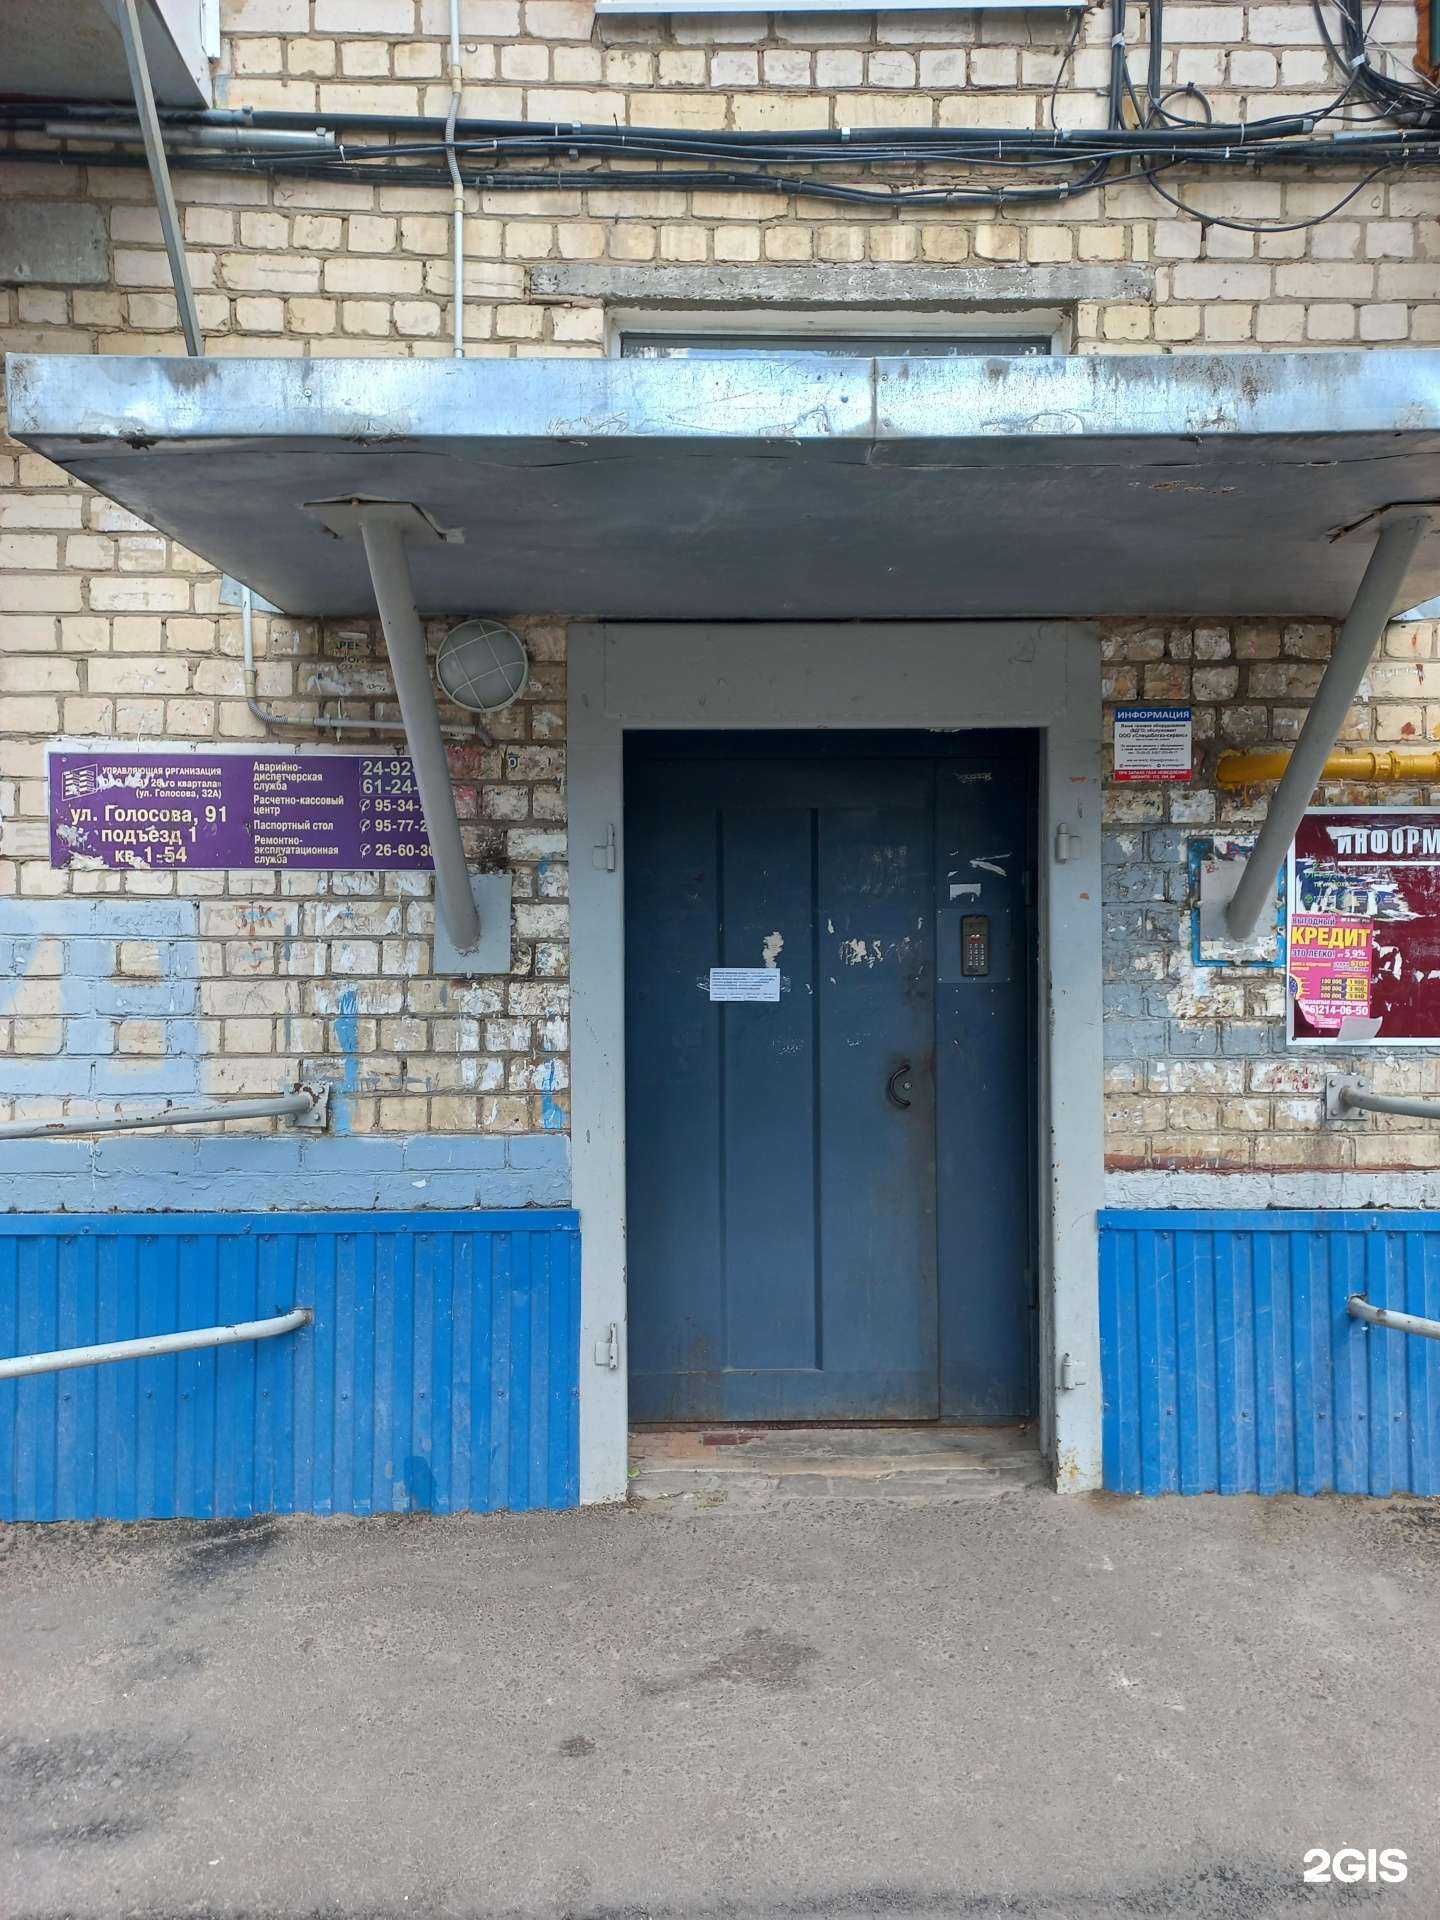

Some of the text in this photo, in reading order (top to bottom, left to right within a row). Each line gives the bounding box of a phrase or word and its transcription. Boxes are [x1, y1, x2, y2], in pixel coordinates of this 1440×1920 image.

[1117, 711, 1190, 719] ИНФОРМАЦИЯ
[103, 766, 222, 777] УПРАВЛЯЮЩАЯ ОРГАНИЗАЦИЯ
[253, 761, 302, 773] Аварийно-
[253, 773, 323, 783] диспетчерская
[253, 781, 288, 792] служба
[135, 788, 222, 799] (ул. Голосова, 32А)
[253, 794, 345, 806] Расчетно-кассовый
[70, 804, 227, 826] ул. Голосова, 91
[253, 806, 281, 816] центр
[253, 819, 334, 832] Паспортный стол
[101, 827, 198, 845] подъезд 1
[254, 835, 303, 846] Ремонтно-
[254, 846, 339, 856] эксплуатационная
[254, 854, 288, 865] служба
[1292, 927, 1371, 949] КРЕДИТ
